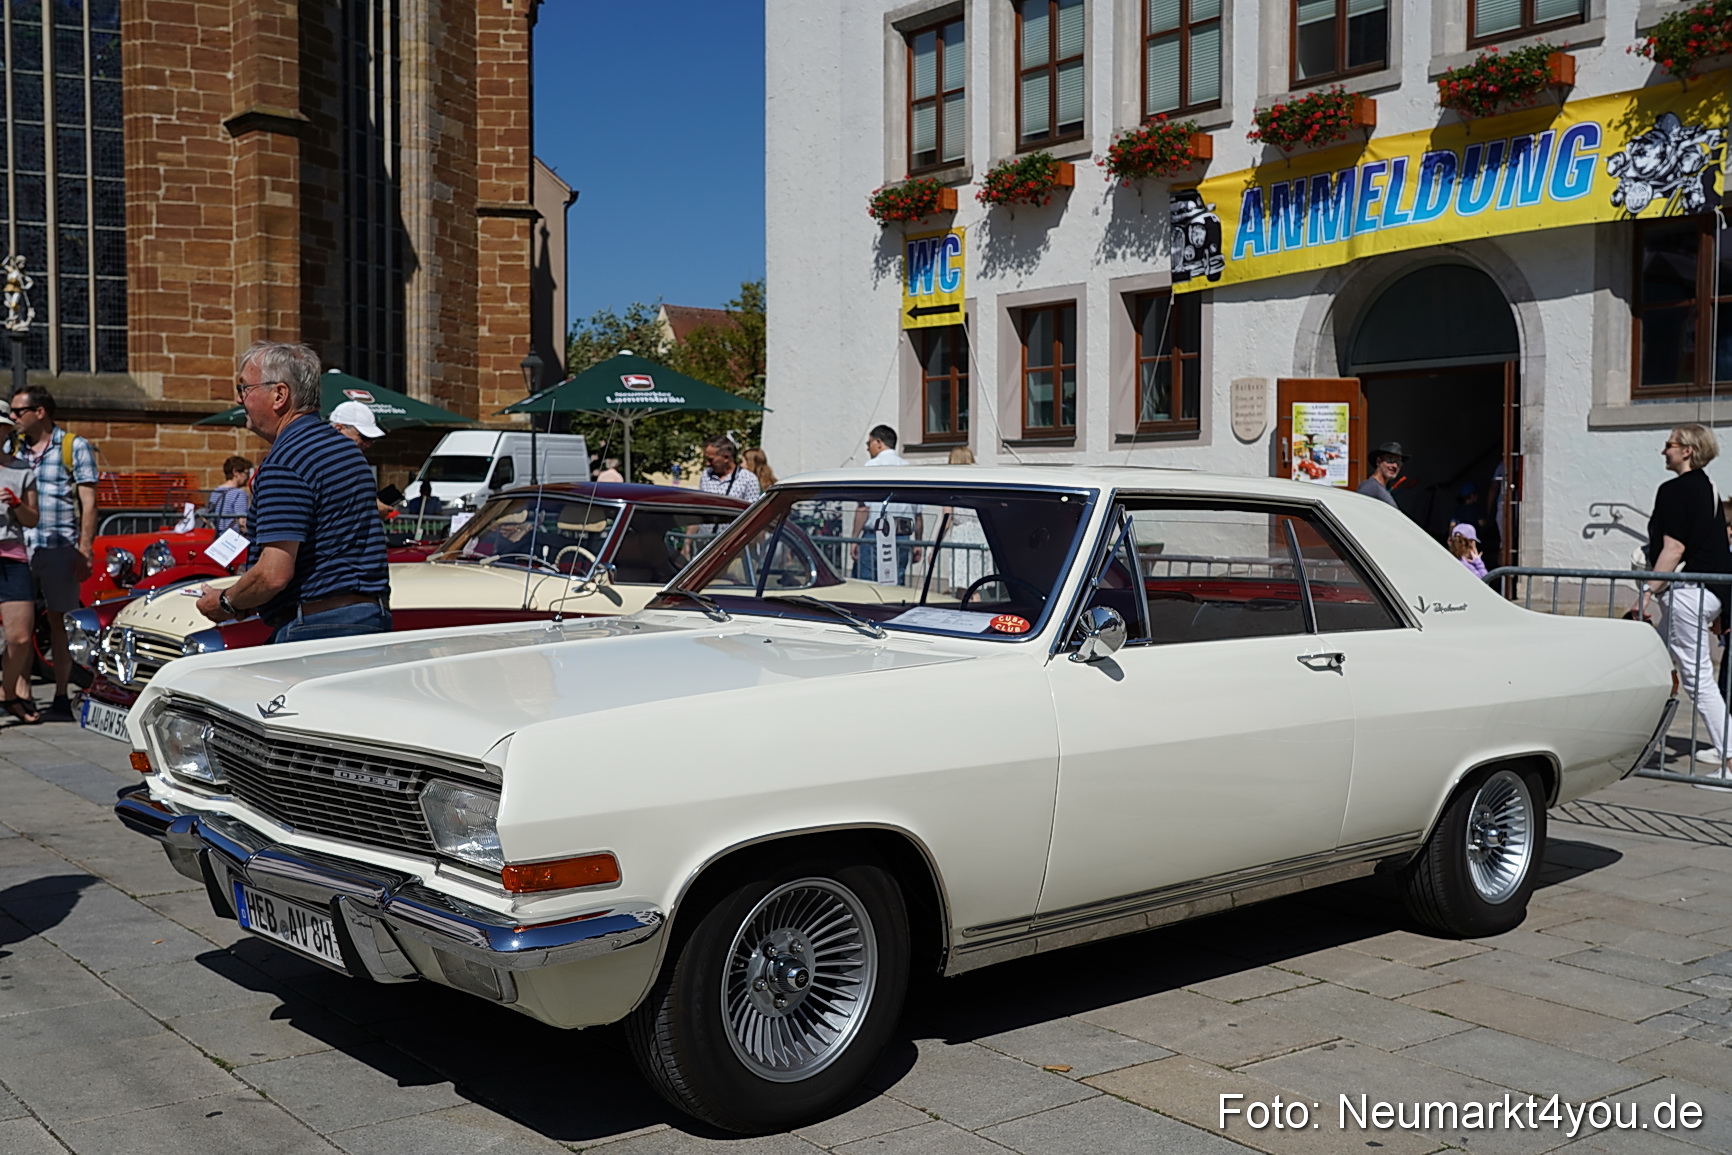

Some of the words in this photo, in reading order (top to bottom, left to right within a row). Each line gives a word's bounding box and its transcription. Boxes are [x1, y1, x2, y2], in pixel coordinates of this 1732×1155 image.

[1231, 121, 1602, 261] ANMELDUNG
[907, 233, 961, 297] WC
[994, 623, 1021, 633] CLUB
[998, 615, 1025, 626] CUBA
[340, 770, 395, 788] OPEL
[245, 890, 278, 933] HEB
[287, 906, 309, 948] AV
